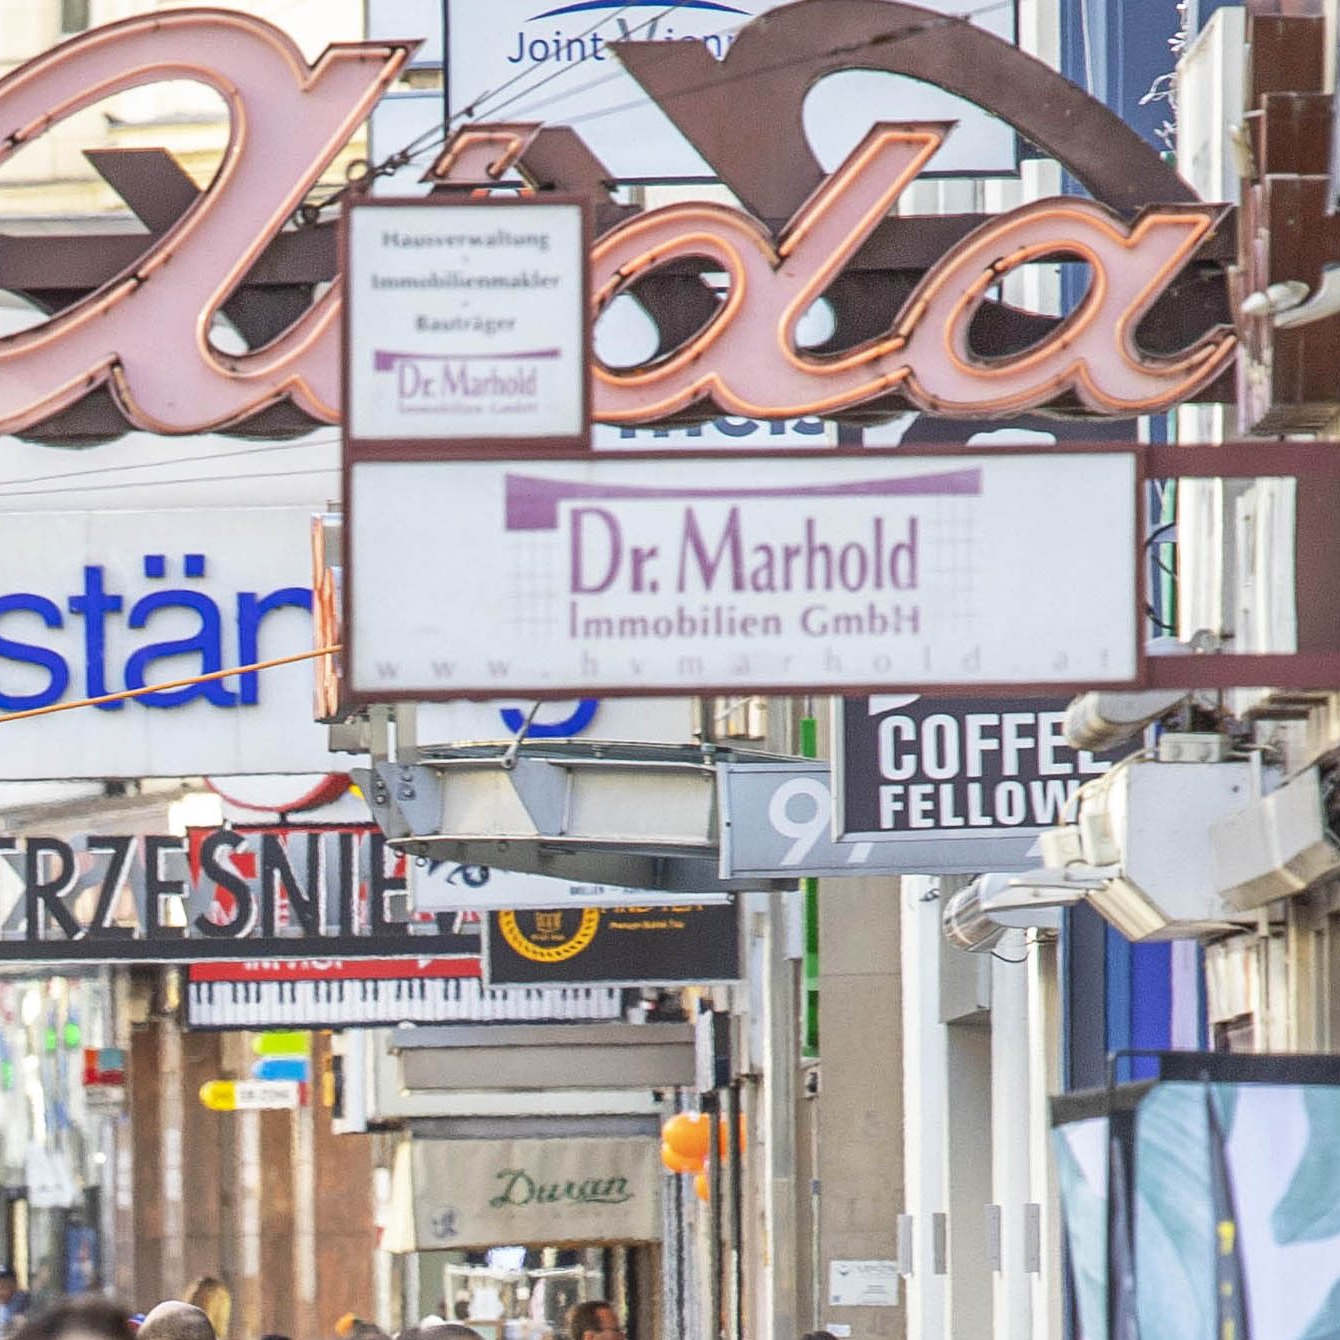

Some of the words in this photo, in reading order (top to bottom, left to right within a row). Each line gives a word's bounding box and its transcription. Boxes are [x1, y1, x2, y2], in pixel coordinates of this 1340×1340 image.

[507, 31, 605, 64] Joint
[381, 229, 551, 250] Hausverwaltung
[370, 271, 560, 290] Immobilienmakler
[415, 313, 517, 335] Bauträger
[441, 362, 538, 398] Marhold
[568, 506, 660, 596] Dr.
[677, 505, 922, 595] Marhold
[568, 600, 783, 641] Immobilien
[800, 602, 921, 639] GmbH
[489, 1168, 636, 1209] Duran
